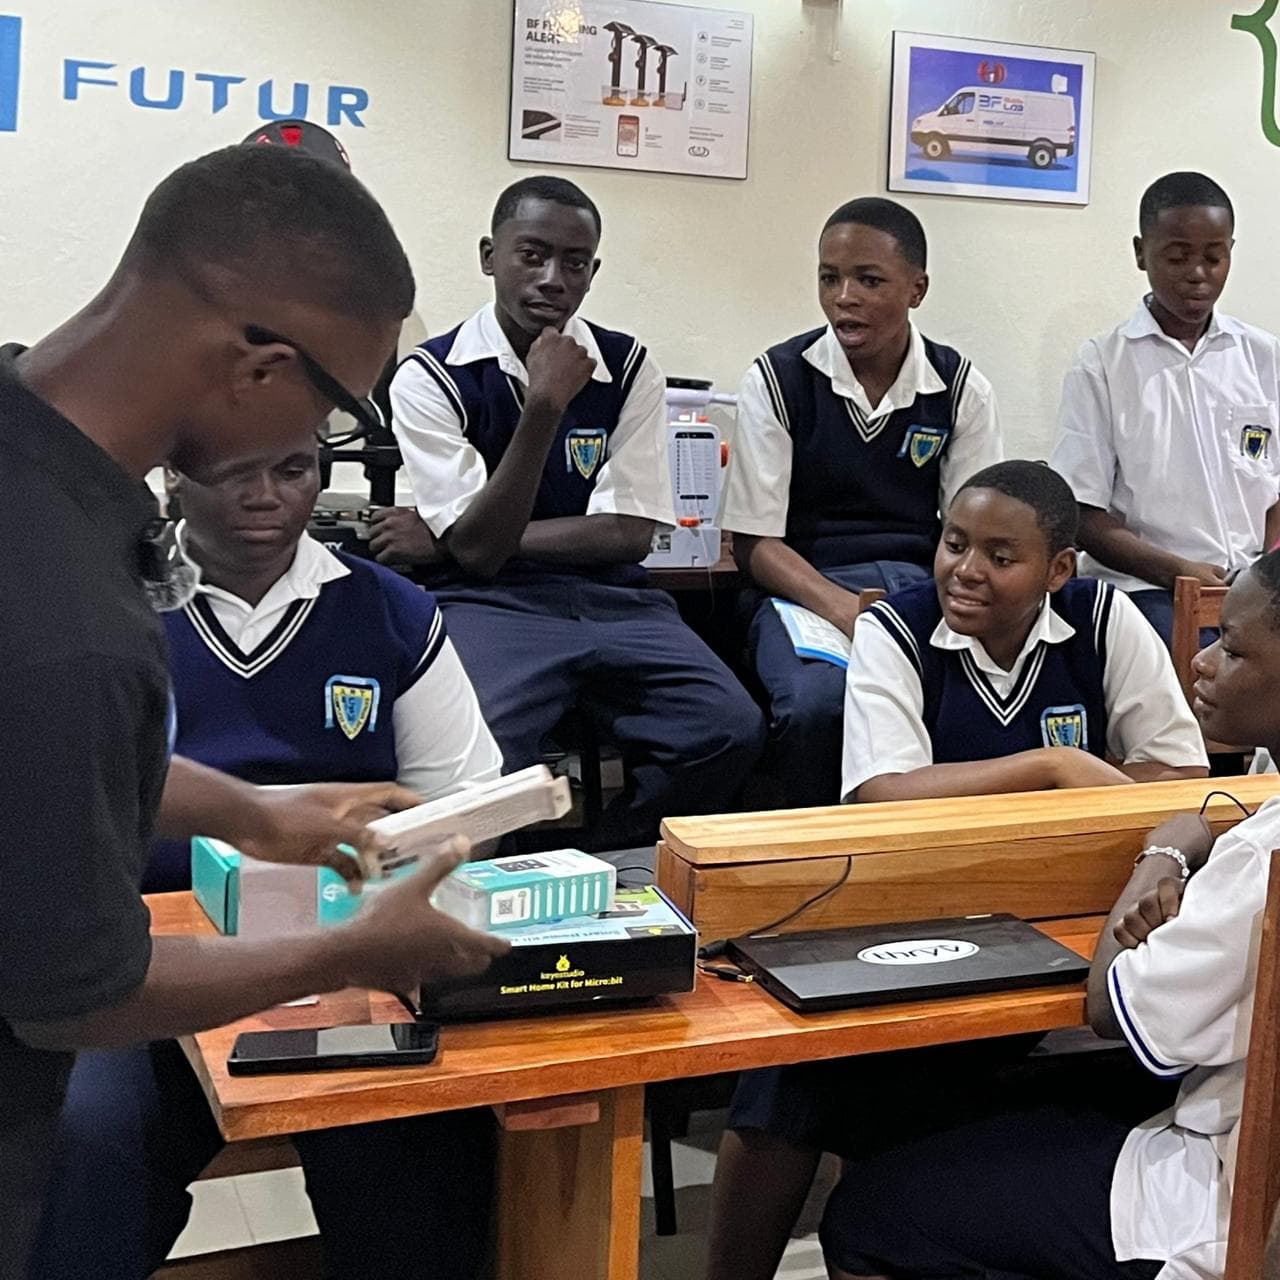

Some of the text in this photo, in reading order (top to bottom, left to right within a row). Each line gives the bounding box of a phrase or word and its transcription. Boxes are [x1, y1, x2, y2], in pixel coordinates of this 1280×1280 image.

[526, 18, 540, 29] BF
[63, 58, 369, 128] FUTUR
[872, 944, 960, 960] thryv
[500, 976, 623, 995] Smart Home Kit for Micro:bit
